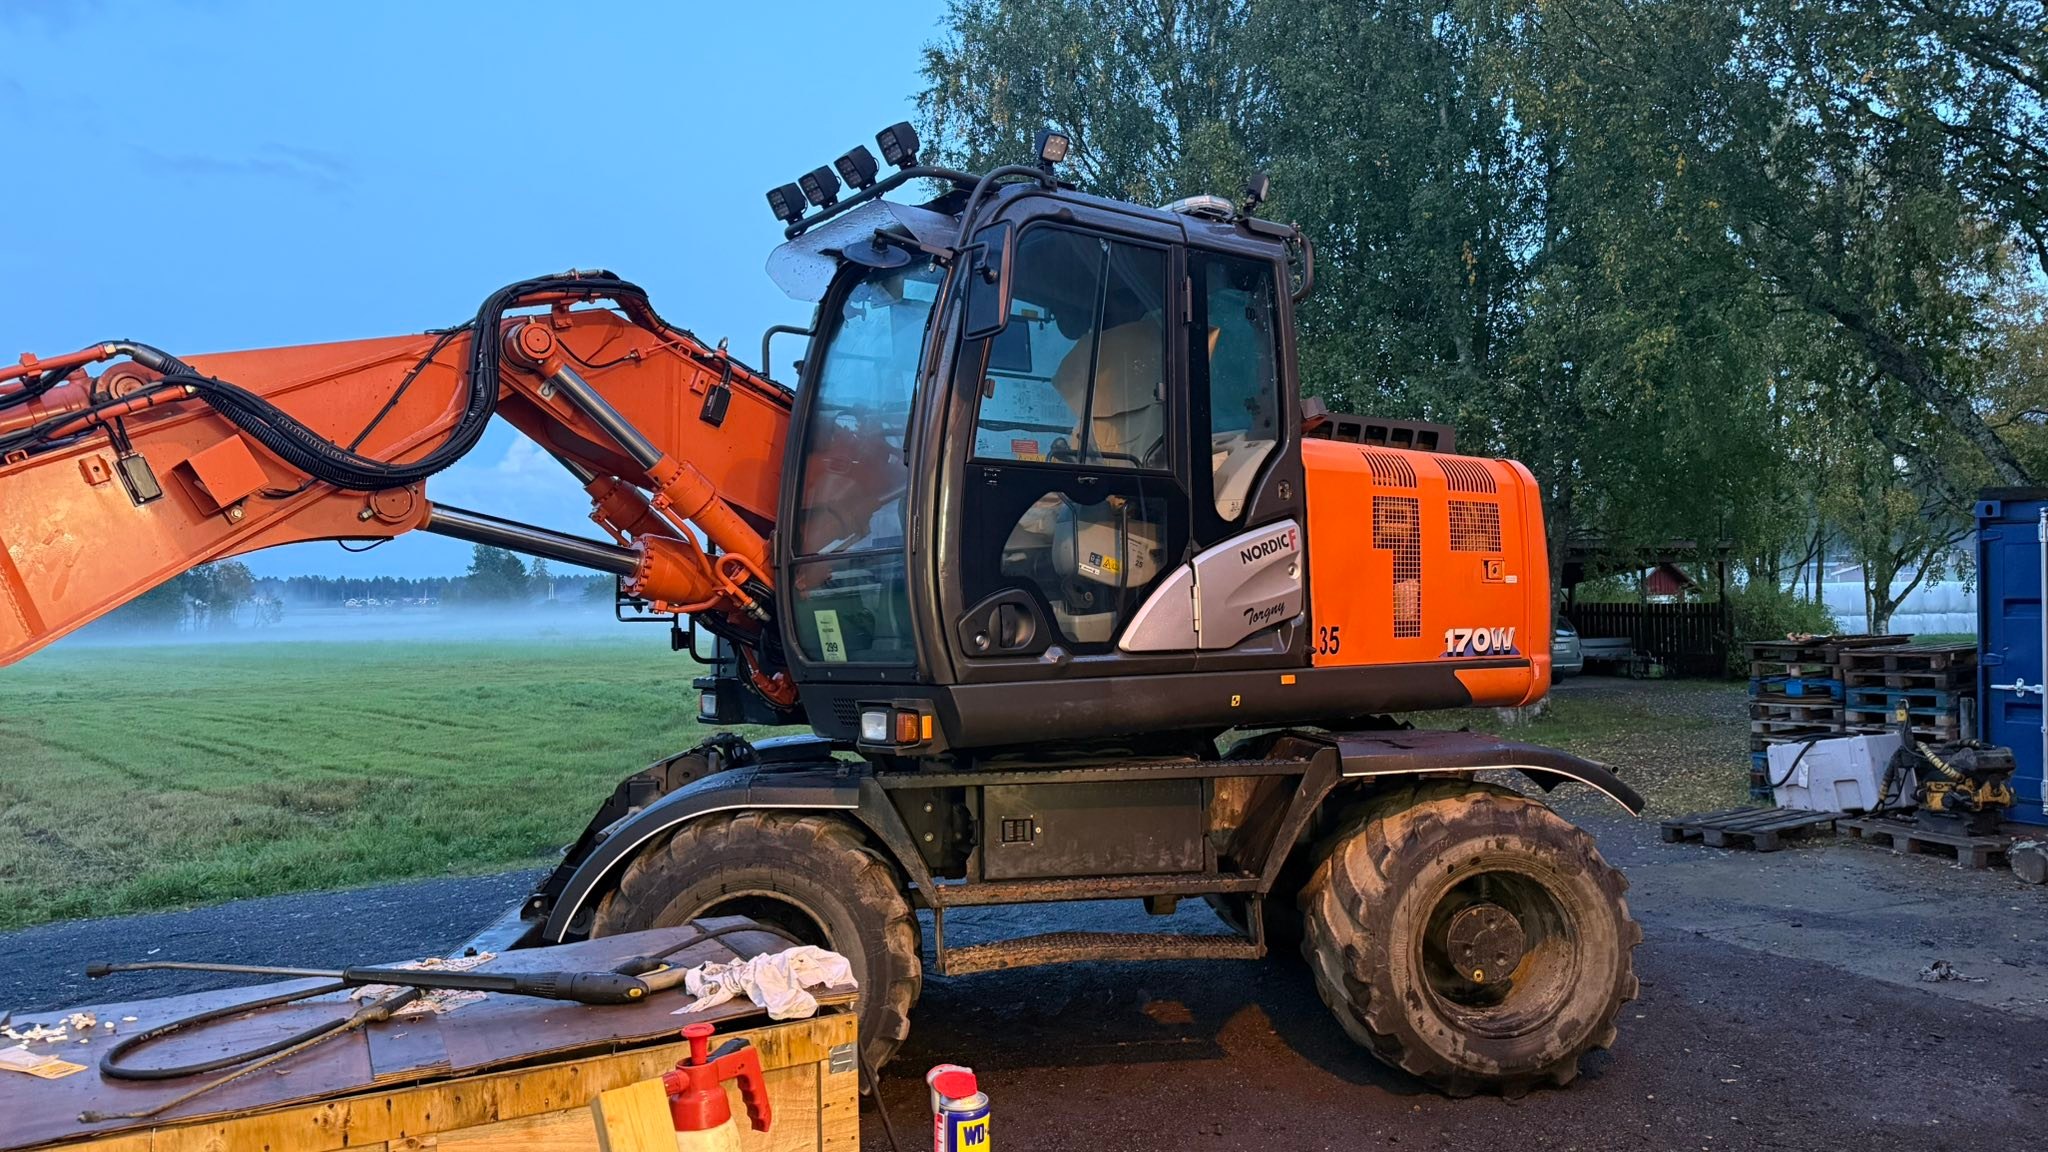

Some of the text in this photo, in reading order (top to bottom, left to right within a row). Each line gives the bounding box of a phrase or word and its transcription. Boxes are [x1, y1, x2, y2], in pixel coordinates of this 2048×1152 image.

[1243, 601, 1286, 626] Torgny
[1319, 626, 1340, 655] 35
[1444, 627, 1516, 655] 170W
